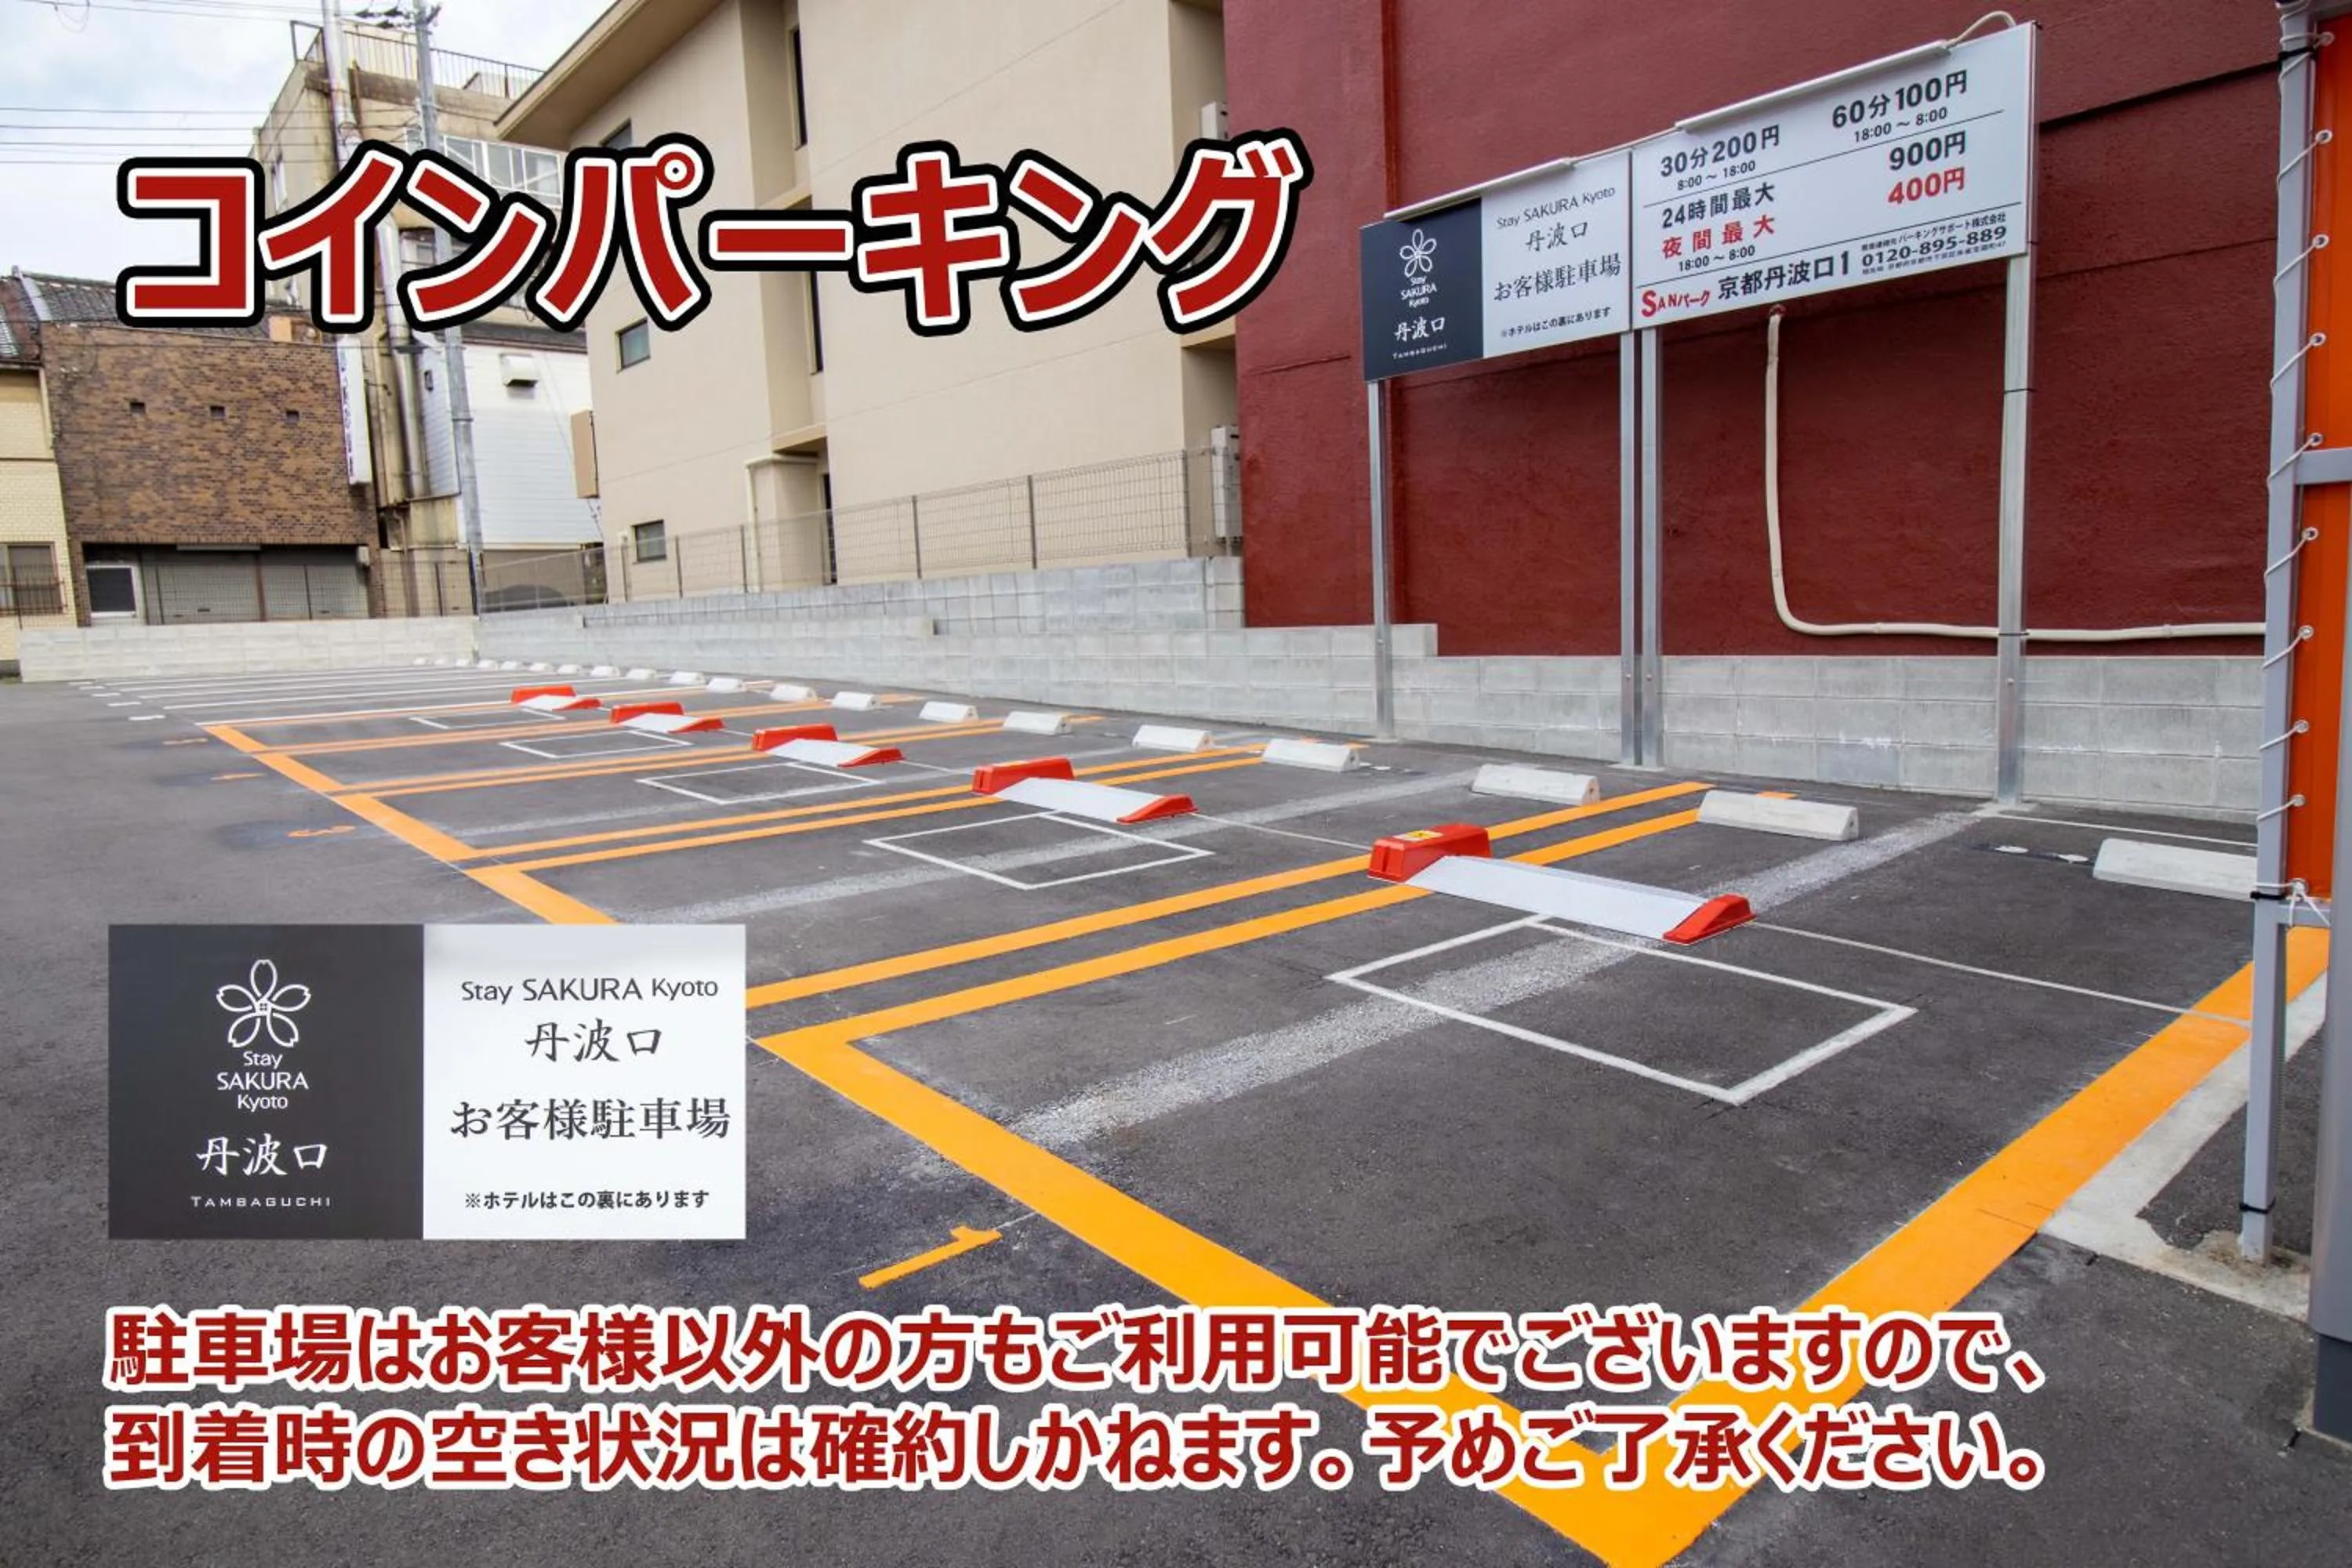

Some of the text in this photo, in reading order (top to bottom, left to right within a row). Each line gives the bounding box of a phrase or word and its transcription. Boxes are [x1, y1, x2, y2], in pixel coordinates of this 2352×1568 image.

[1832, 69, 1967, 129] 60分100円
[1854, 122, 1892, 143] 18:00
[1915, 107, 1947, 126] 8:00
[1660, 124, 1780, 177] 30分200円
[1889, 130, 1966, 171] 900円
[1677, 175, 1702, 191] 8:00
[1723, 160, 1755, 178] 18:00
[1888, 166, 1965, 205] 400円
[1497, 187, 1616, 229] Stay SAKURA Kyoto
[1662, 181, 1775, 229] 24時間最大
[1526, 222, 1588, 252] 丹波口
[1662, 214, 1775, 260] 夜間最大
[1862, 226, 2007, 267] 0120-895-889
[1494, 252, 1622, 302] お客様駐車場
[1679, 255, 1710, 271] 18:00
[1729, 245, 1755, 261] 8:00
[1400, 283, 1438, 300] SAKURA
[1641, 289, 1711, 318] SANパーク
[1718, 250, 1849, 300] 京都丹波口1
[1394, 316, 1445, 343] 丹波口
[858, 1225, 1004, 1290] 1
